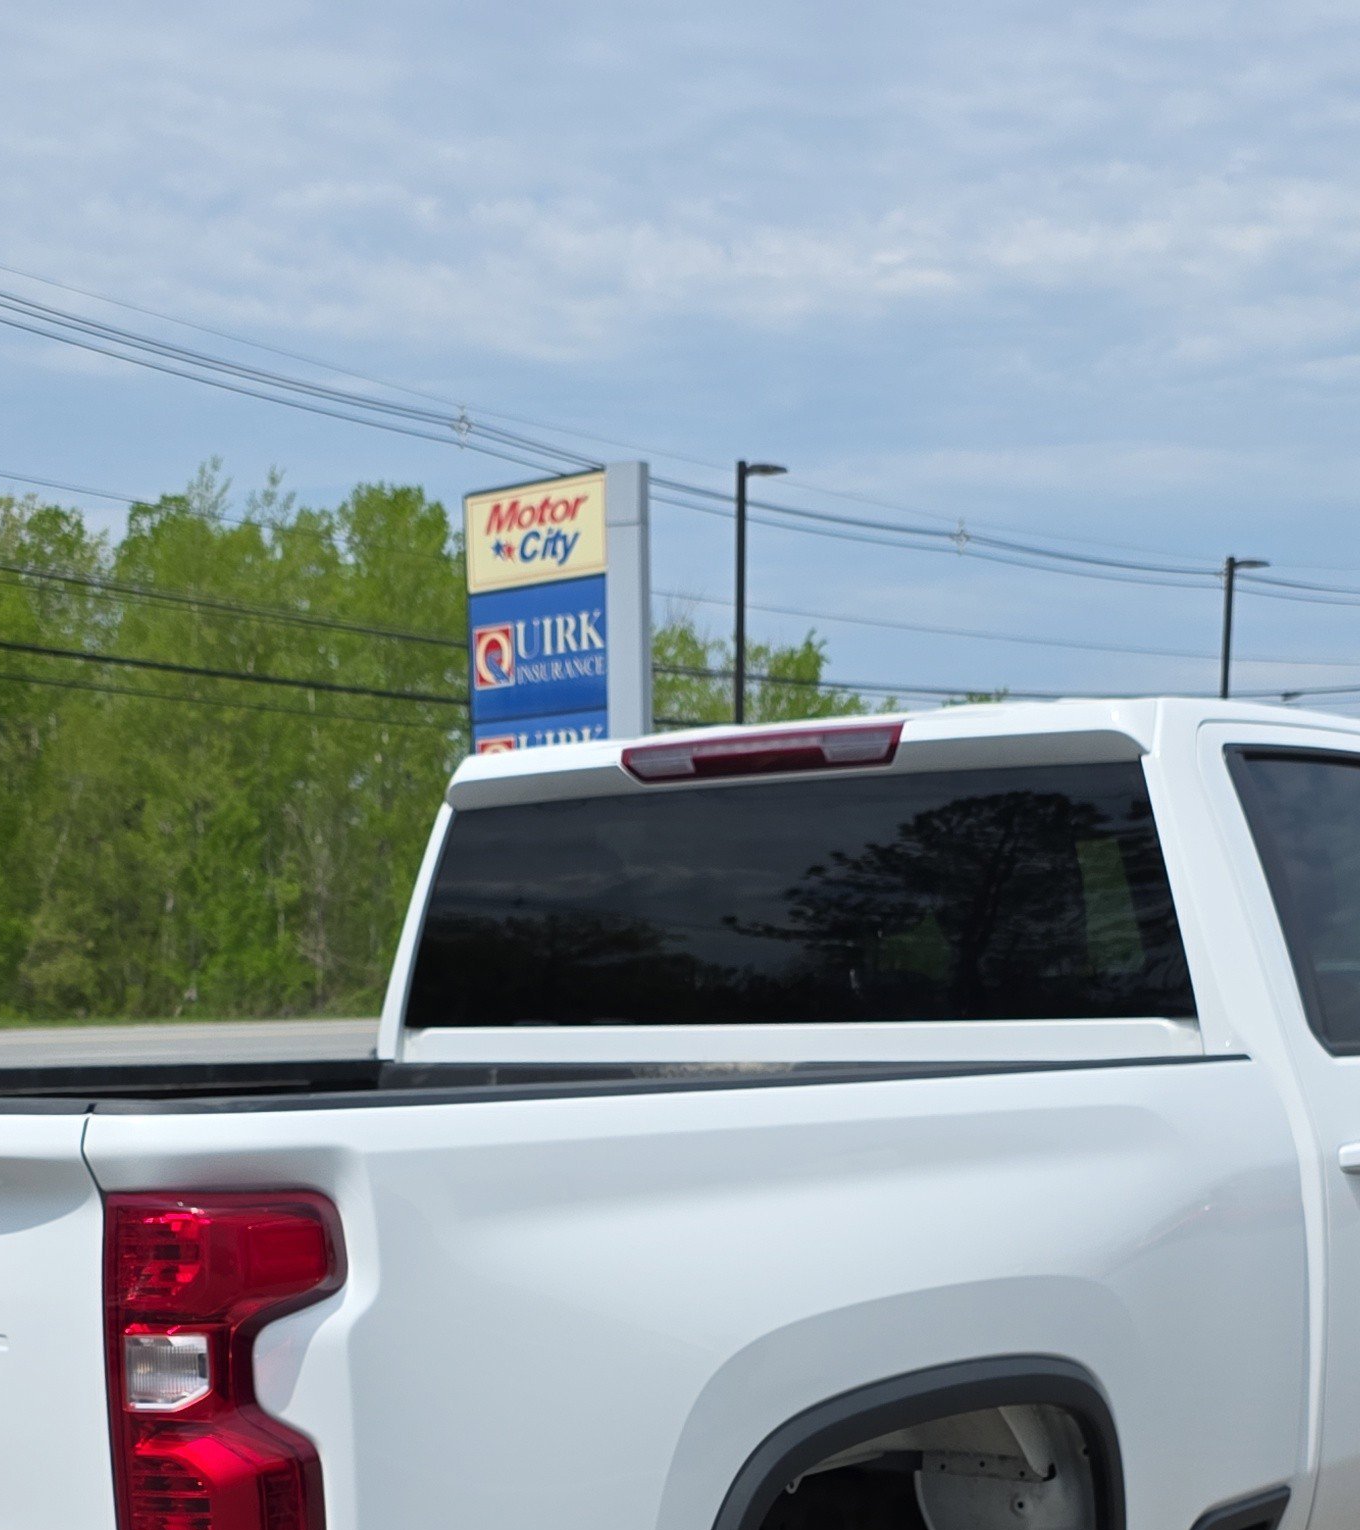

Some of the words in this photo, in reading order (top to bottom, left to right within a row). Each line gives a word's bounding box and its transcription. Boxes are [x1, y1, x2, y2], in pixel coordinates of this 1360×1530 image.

[486, 495, 588, 536] Motor
[519, 527, 579, 566] City
[516, 655, 606, 685] INSURANCE
